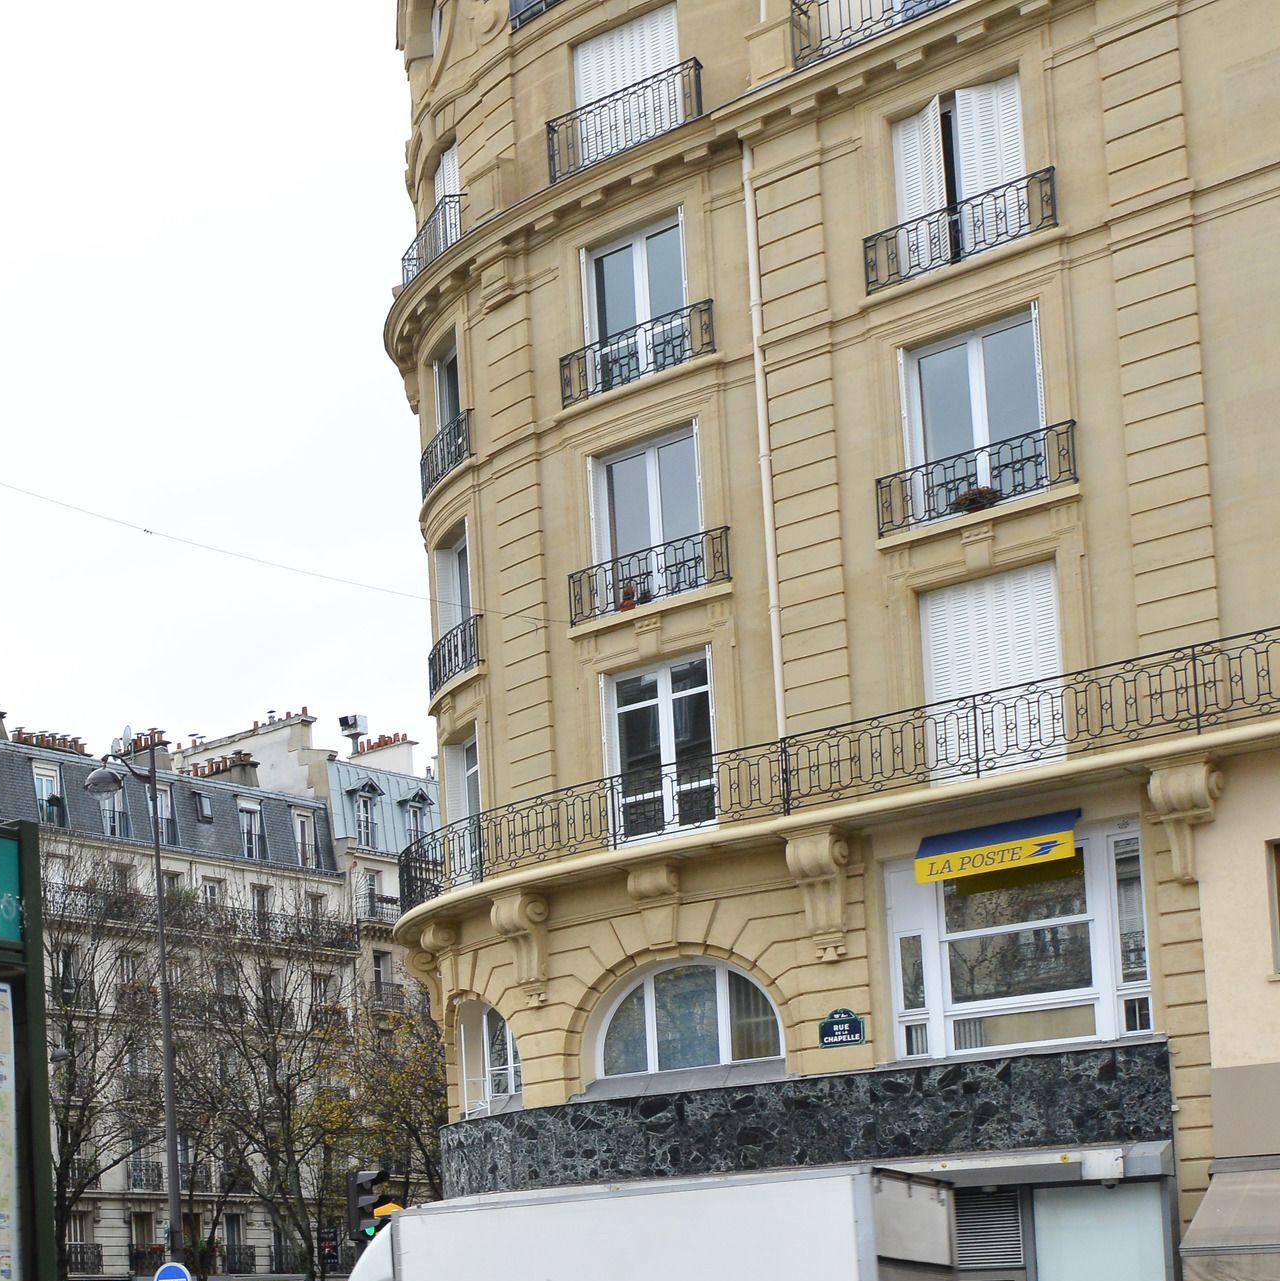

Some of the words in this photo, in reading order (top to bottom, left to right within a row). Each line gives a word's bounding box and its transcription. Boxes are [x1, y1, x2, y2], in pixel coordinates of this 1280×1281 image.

[927, 862, 953, 877] LA
[957, 846, 1024, 873] POSTE
[833, 1023, 850, 1031] RUE
[824, 1034, 860, 1043] CHAPELLE
